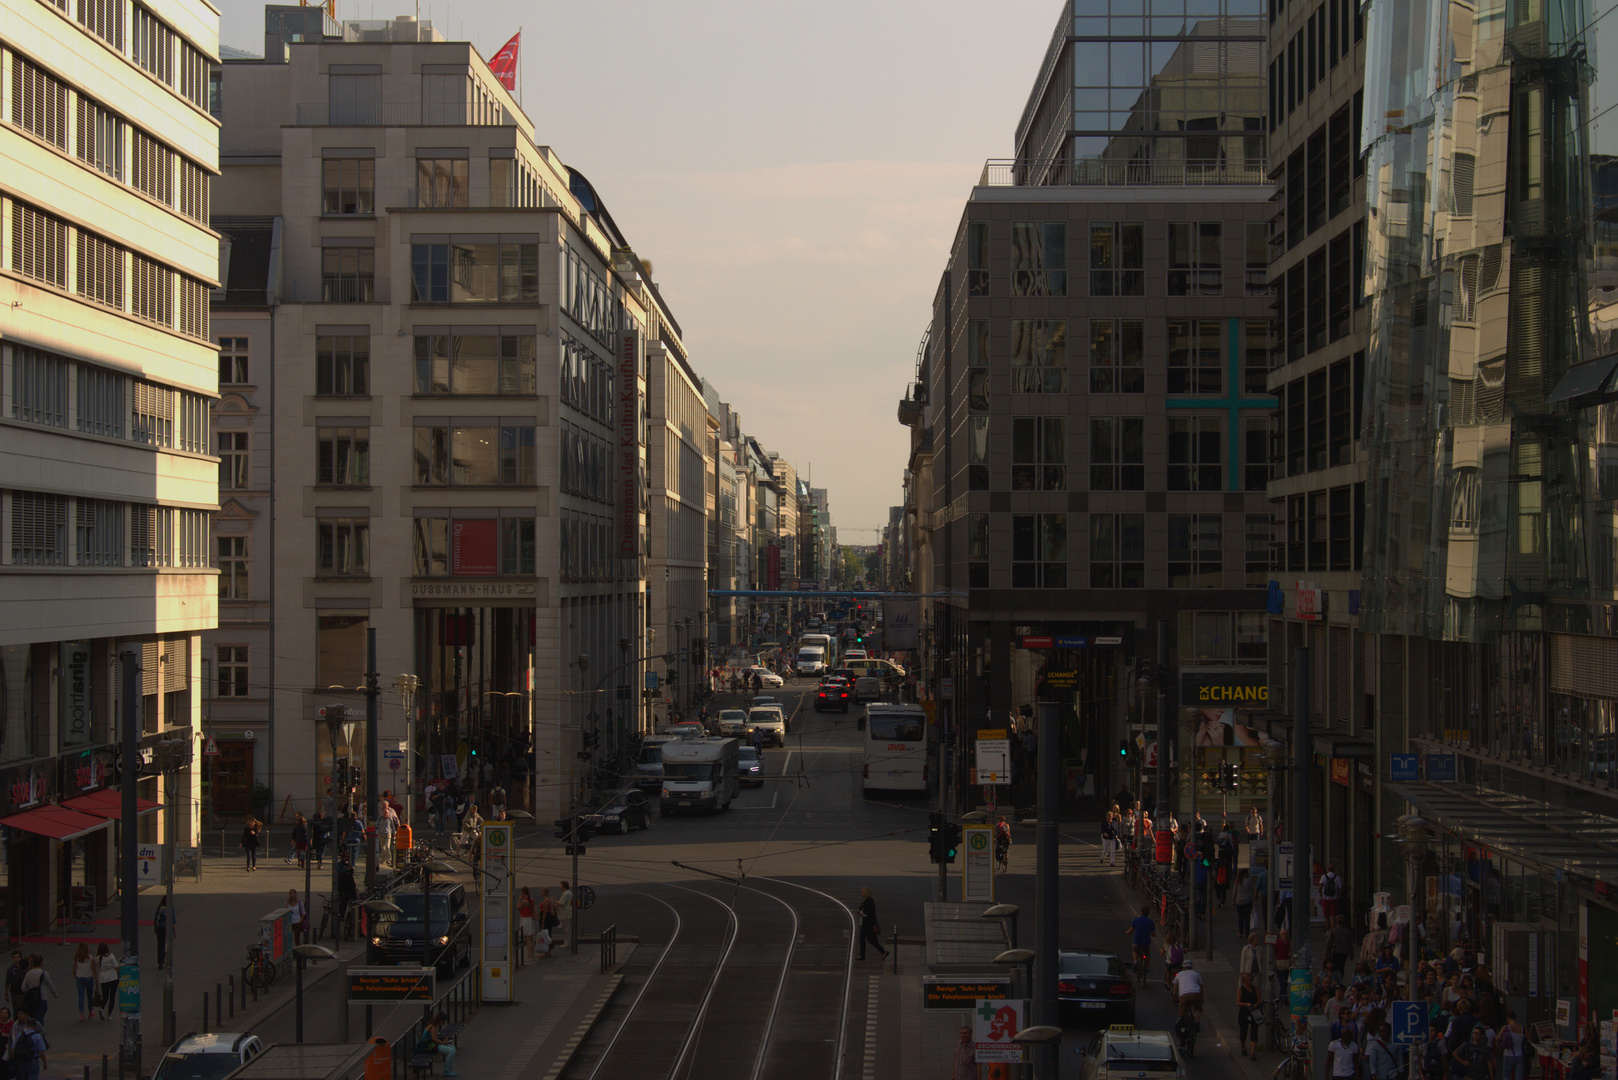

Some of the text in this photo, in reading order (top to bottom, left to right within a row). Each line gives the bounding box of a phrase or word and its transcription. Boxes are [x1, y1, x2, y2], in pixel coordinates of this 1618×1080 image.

[620, 450, 635, 475] das
[620, 480, 635, 553] Dussmann
[454, 523, 463, 570] Dussmann
[413, 584, 513, 594] DUSSMANN-HAUS
[1407, 1012, 1420, 1033] P
